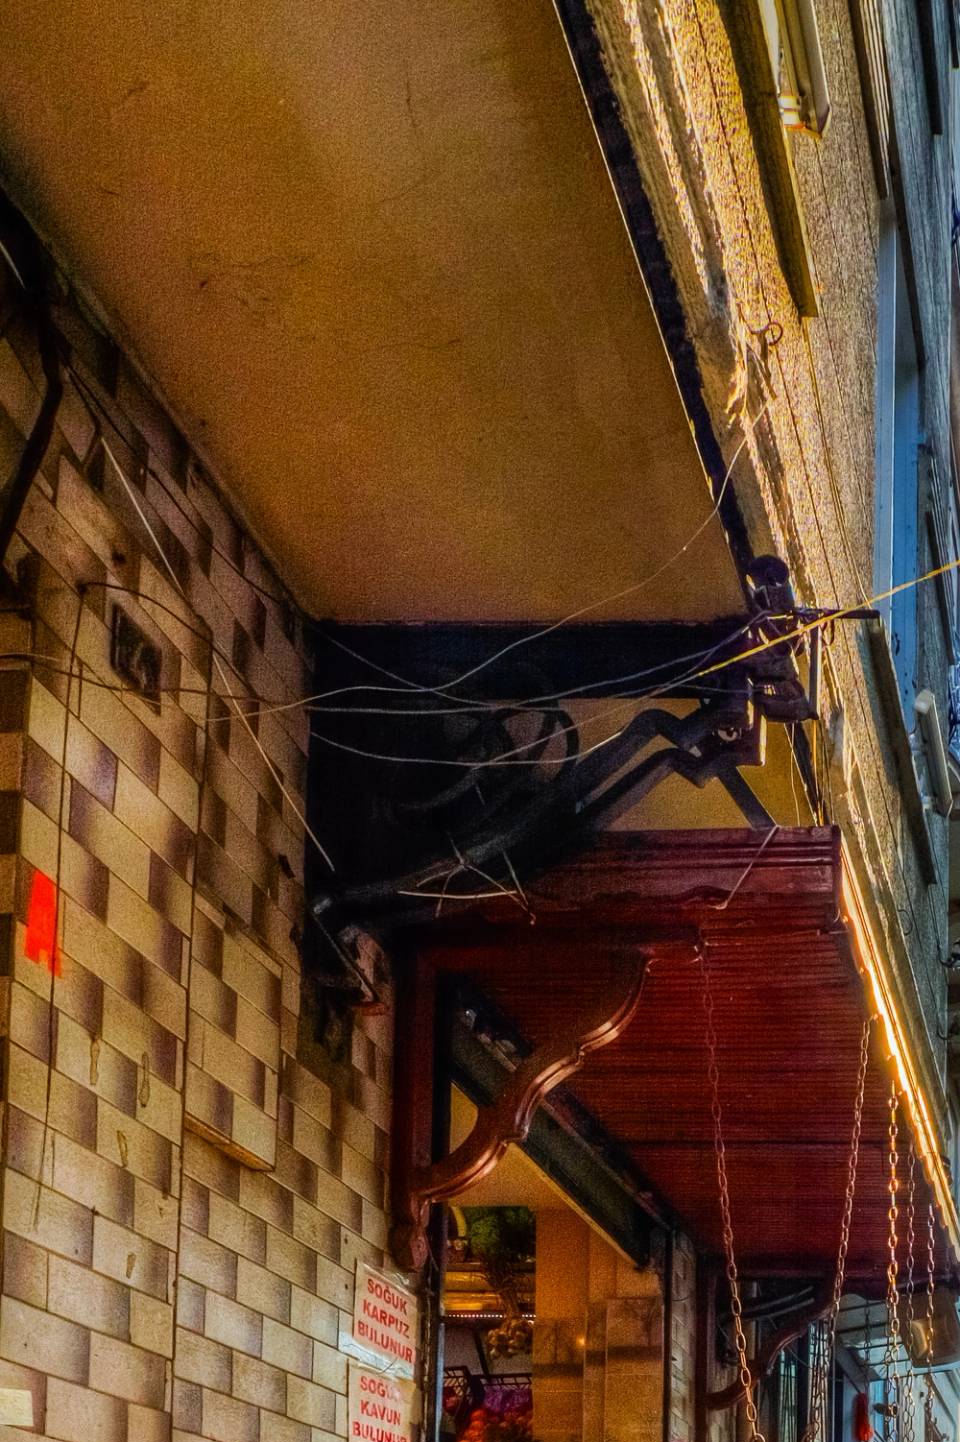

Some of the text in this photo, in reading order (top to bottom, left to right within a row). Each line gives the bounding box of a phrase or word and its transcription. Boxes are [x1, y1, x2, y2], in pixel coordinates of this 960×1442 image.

[367, 1278, 407, 1315] SOĞUK
[363, 1299, 410, 1339] KARPUZ
[358, 1320, 413, 1363] BULUNUR
[361, 1400, 401, 1425] KAVUN
